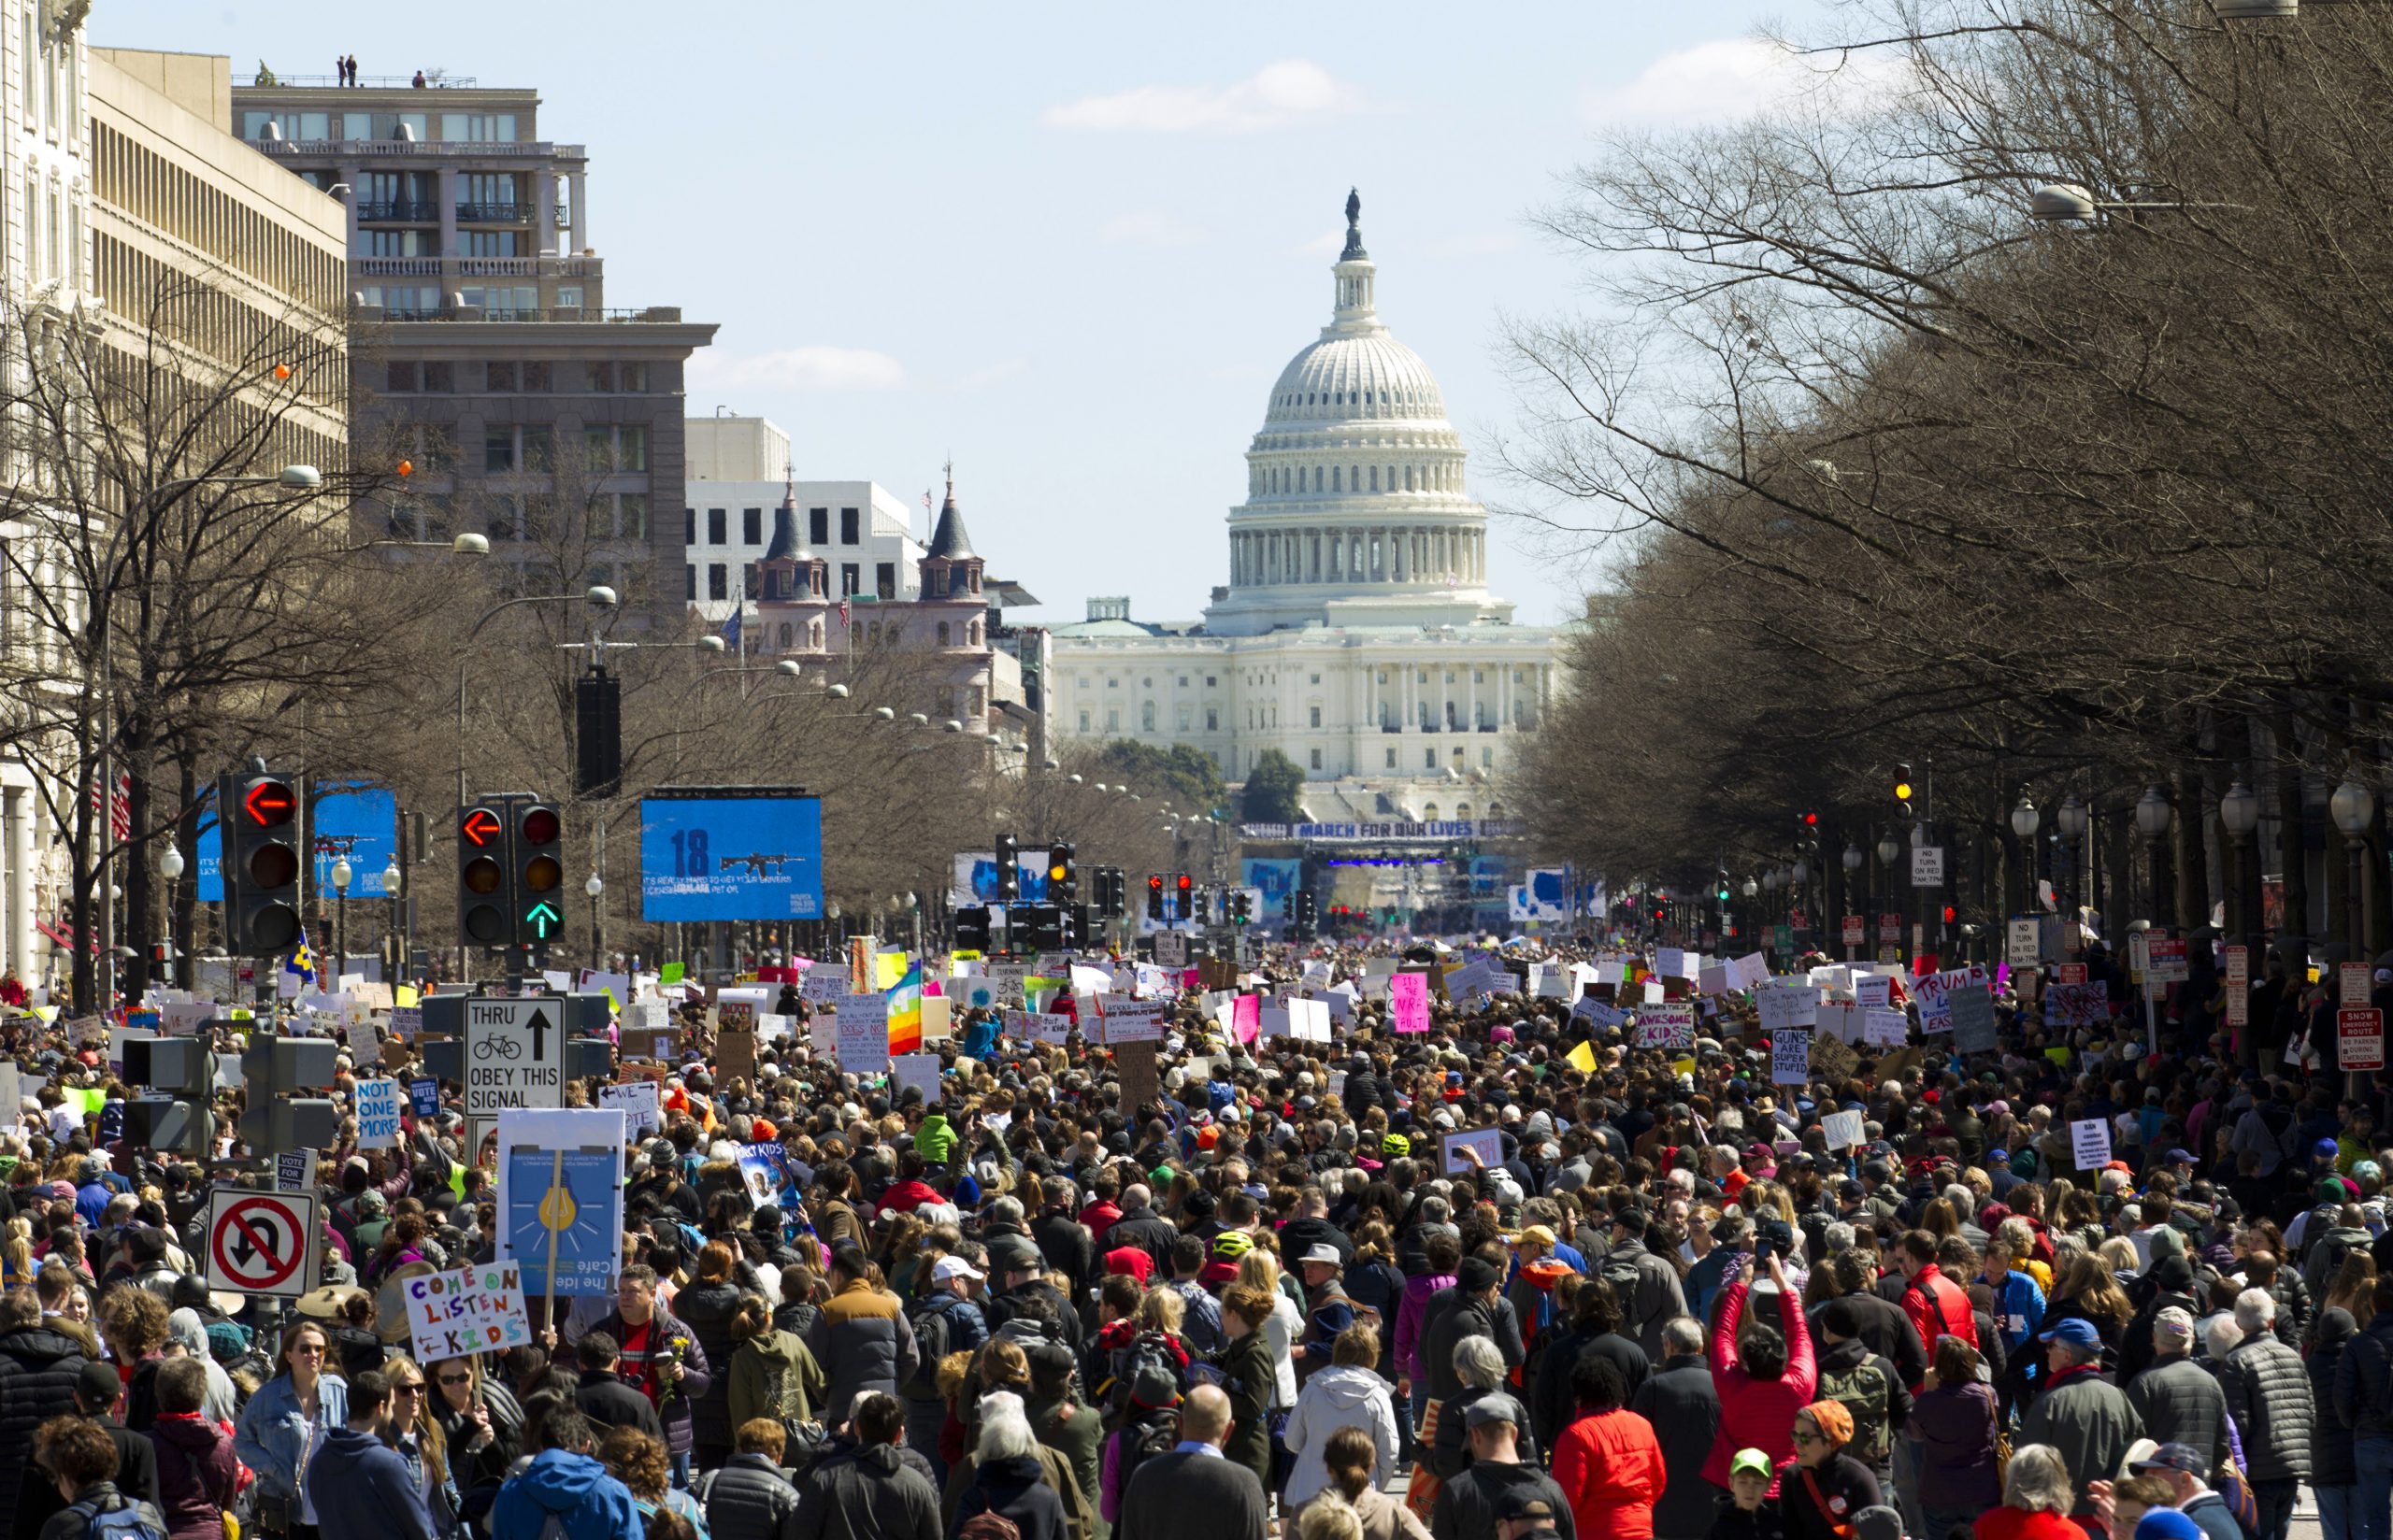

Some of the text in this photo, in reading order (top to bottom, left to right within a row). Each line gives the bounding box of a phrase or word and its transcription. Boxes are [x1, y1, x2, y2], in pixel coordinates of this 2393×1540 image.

[1299, 821, 1472, 837] MARCH FOR OUR LIVES
[670, 829, 709, 877] 18
[2015, 934, 2032, 943] TURN
[2010, 956, 2038, 964] 7AM-7PM
[1404, 987, 1417, 996] THE
[1913, 967, 1983, 1002] TRUMP
[472, 1006, 515, 1024] THRU
[1638, 1014, 1691, 1027] AWESOME
[2348, 1012, 2373, 1020] SNOW
[840, 1022, 888, 1034] DOES NOT
[1647, 1026, 1681, 1039] KIDS
[1774, 1031, 1808, 1045] GUNS
[1780, 1044, 1801, 1053] ARE
[1774, 1053, 1807, 1063] SUPER
[1773, 1062, 1807, 1074] STUPID
[470, 1068, 557, 1086] OBEY THIS
[358, 1082, 391, 1098] NOT
[411, 1087, 437, 1098] VOTE
[616, 1085, 638, 1099] WE
[470, 1091, 530, 1108] SIGNAL
[632, 1097, 654, 1110] NOT
[359, 1100, 395, 1117] ONE
[359, 1118, 399, 1137] MORE!
[758, 1142, 782, 1158] KIDS
[281, 1155, 304, 1167] VOTE
[281, 1168, 299, 1177] FOR
[577, 1260, 611, 1274] Café
[411, 1266, 518, 1300] COME ON
[554, 1276, 579, 1290] Ide
[463, 1319, 469, 1327] 2
[444, 1319, 522, 1354] KIDS
